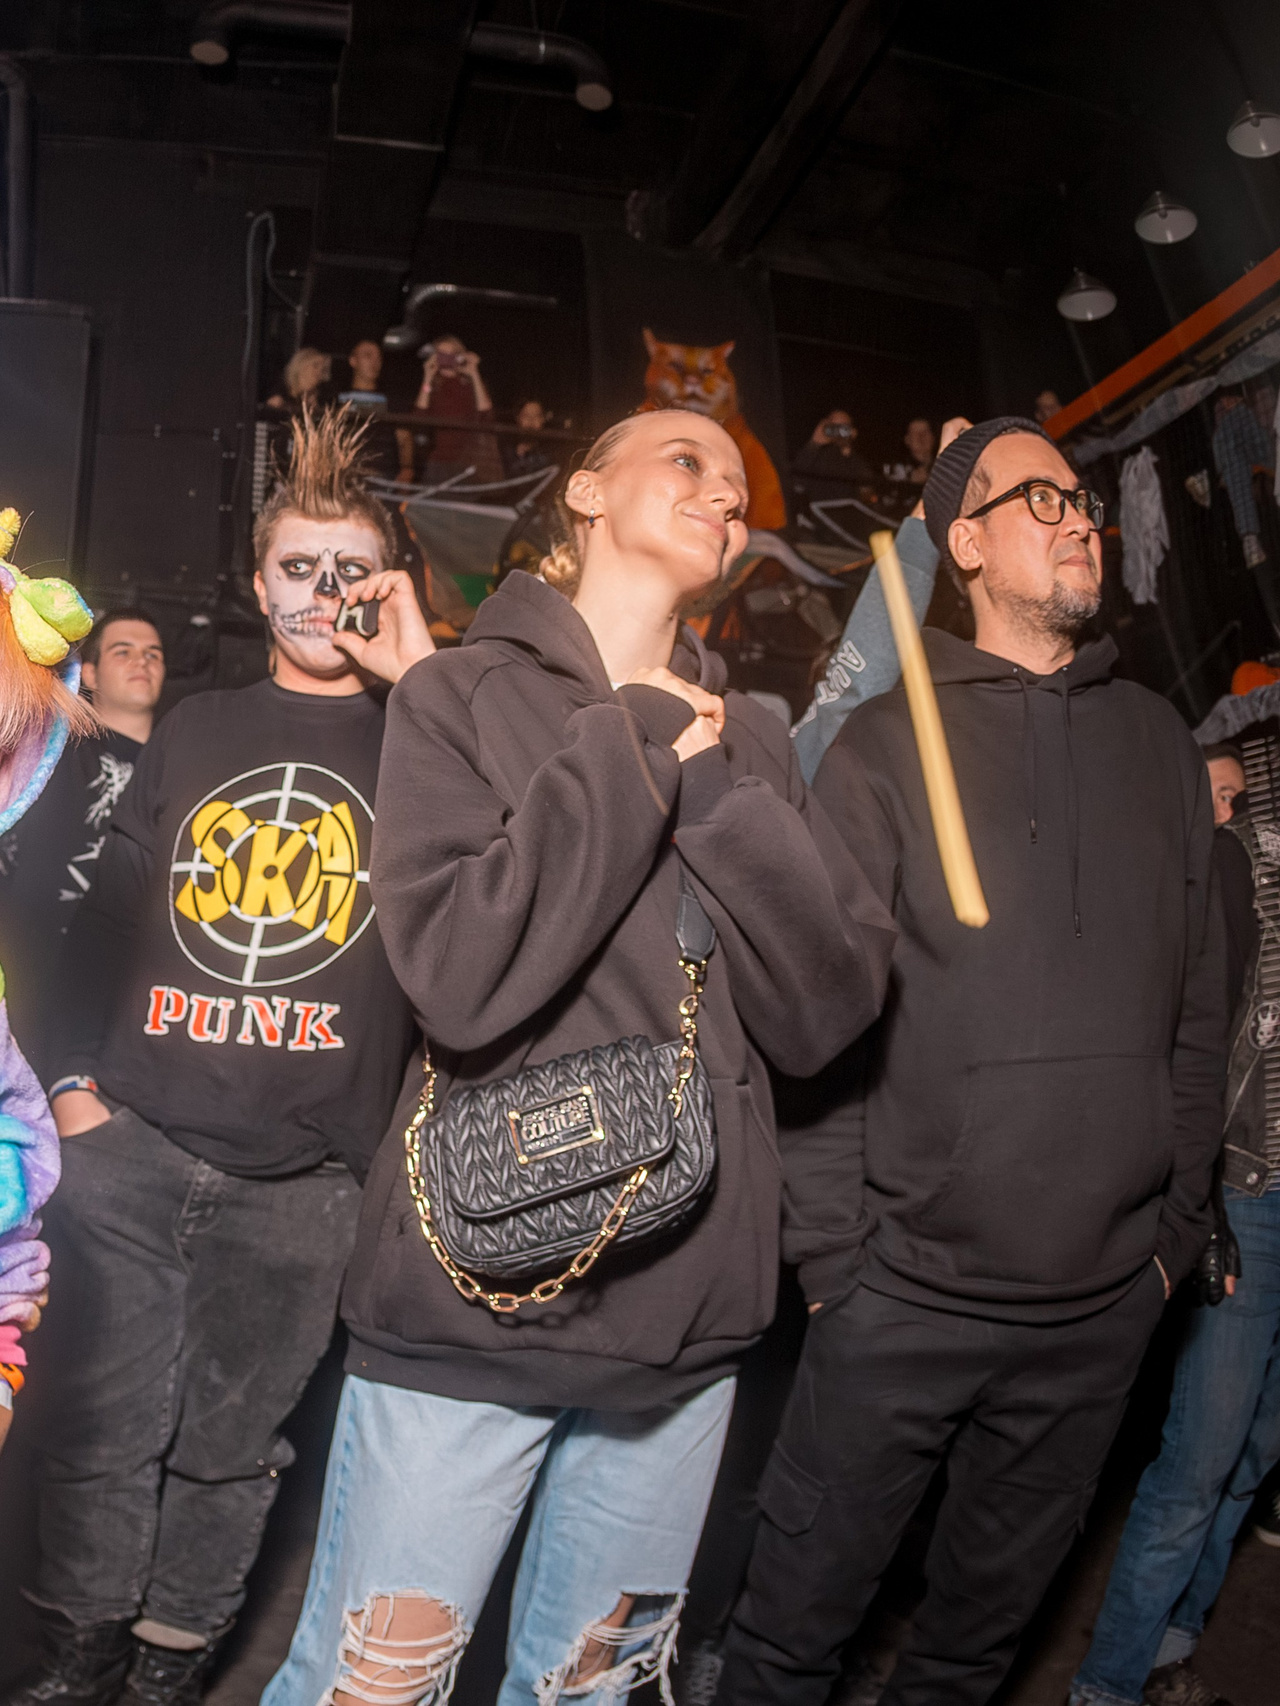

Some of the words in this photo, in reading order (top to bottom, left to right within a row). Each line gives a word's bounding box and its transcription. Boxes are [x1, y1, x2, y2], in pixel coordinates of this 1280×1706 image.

[175, 800, 360, 945] SKA
[144, 985, 345, 1051] PUNK
[521, 1106, 592, 1142] COUTURE
